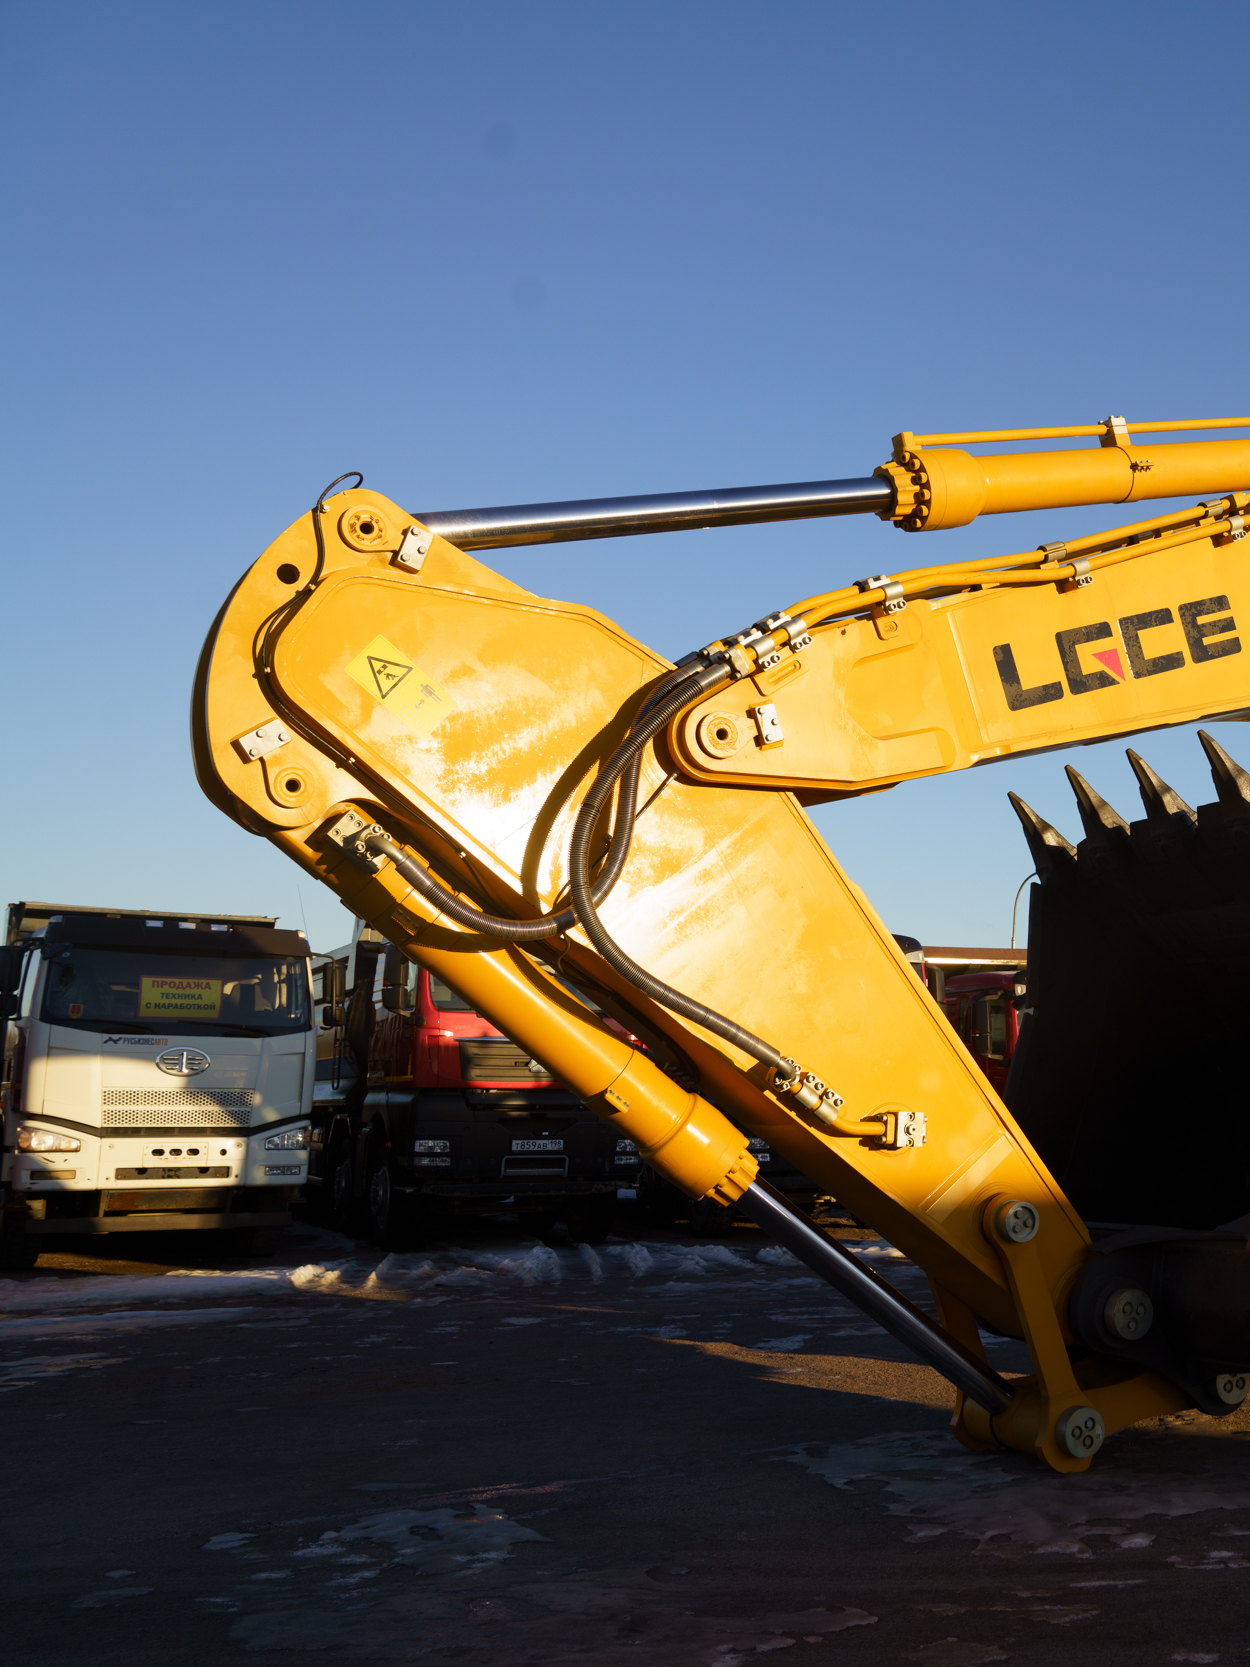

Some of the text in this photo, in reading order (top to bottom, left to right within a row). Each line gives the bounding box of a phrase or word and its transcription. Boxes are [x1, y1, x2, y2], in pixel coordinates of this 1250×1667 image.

[993, 595, 1242, 711] LGCE
[151, 980, 212, 990] ПРОДАЖА
[160, 992, 203, 1000] ТЕХНИКА
[154, 1002, 216, 1010] НАРАБОТКОЙ
[122, 1037, 168, 1046] РУСБИЗНЕСАВТО
